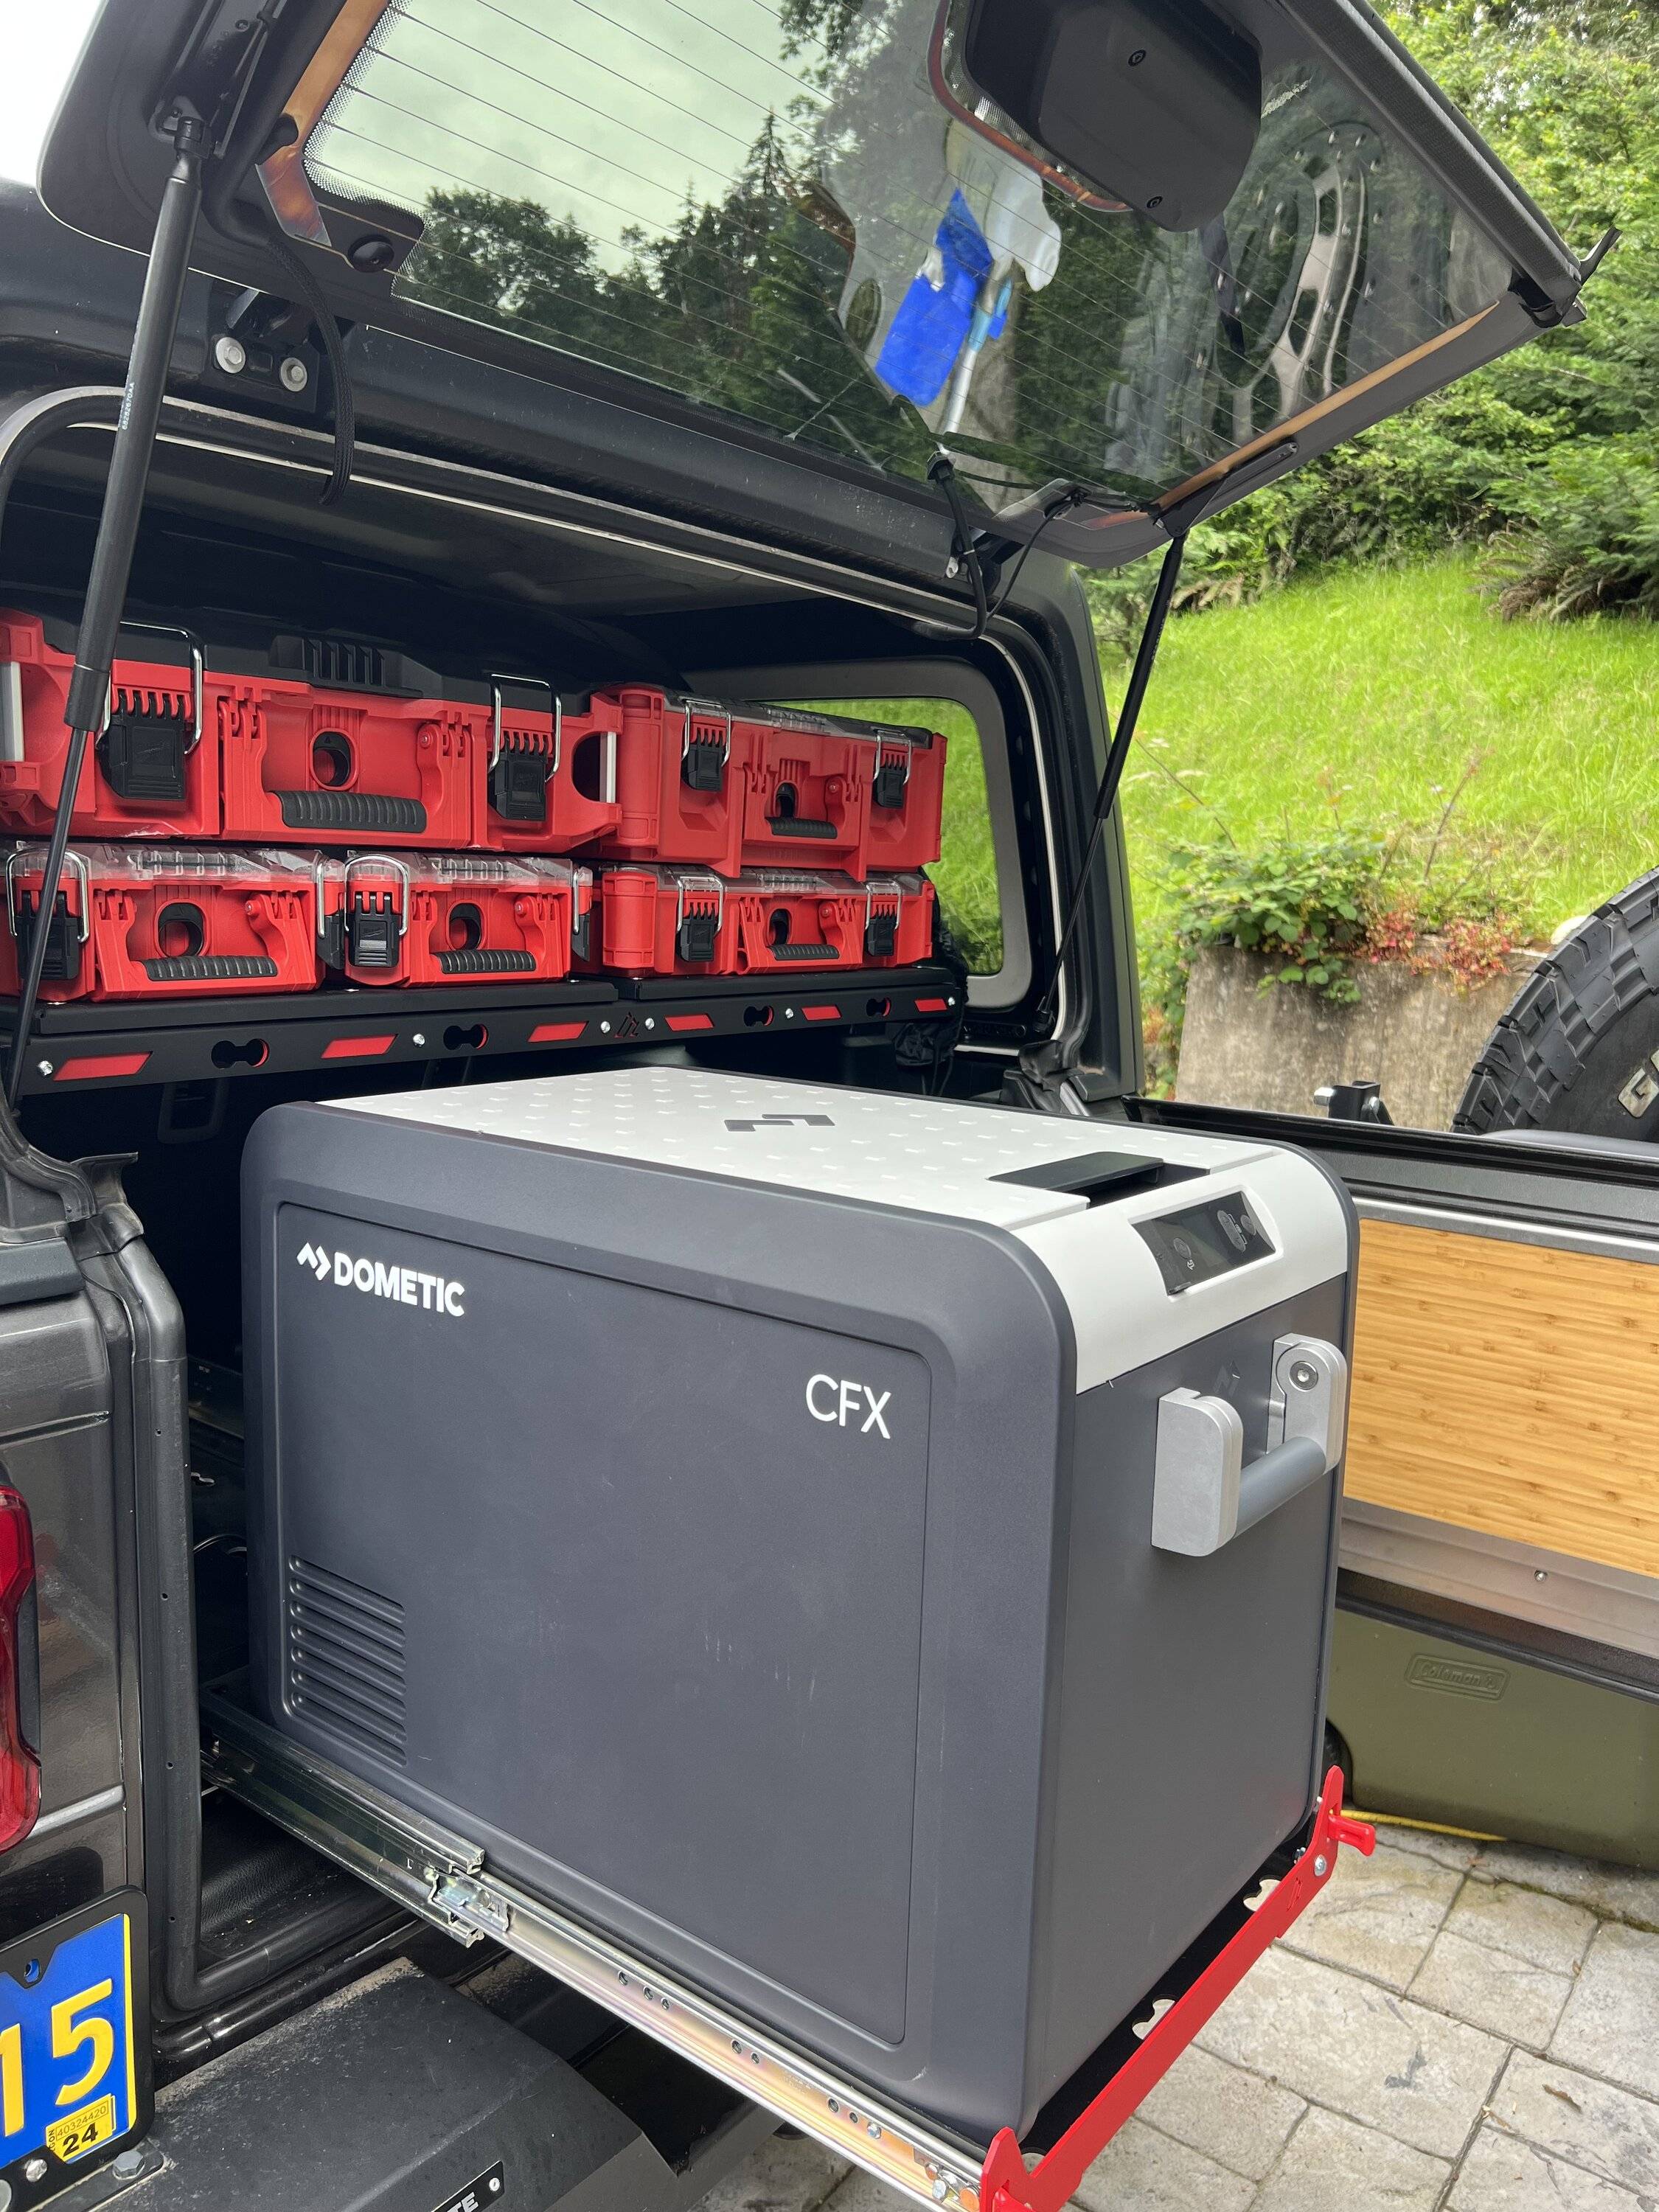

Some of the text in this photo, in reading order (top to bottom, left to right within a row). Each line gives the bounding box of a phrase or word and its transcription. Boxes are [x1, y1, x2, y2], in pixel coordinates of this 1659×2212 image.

[1618, 1047, 1659, 1118] G
[334, 1251, 465, 1318] DOMETIC
[806, 1374, 891, 1439] CFX
[0, 1978, 114, 2137] 15
[57, 2105, 107, 2137] 40324420
[62, 2121, 98, 2157] 24
